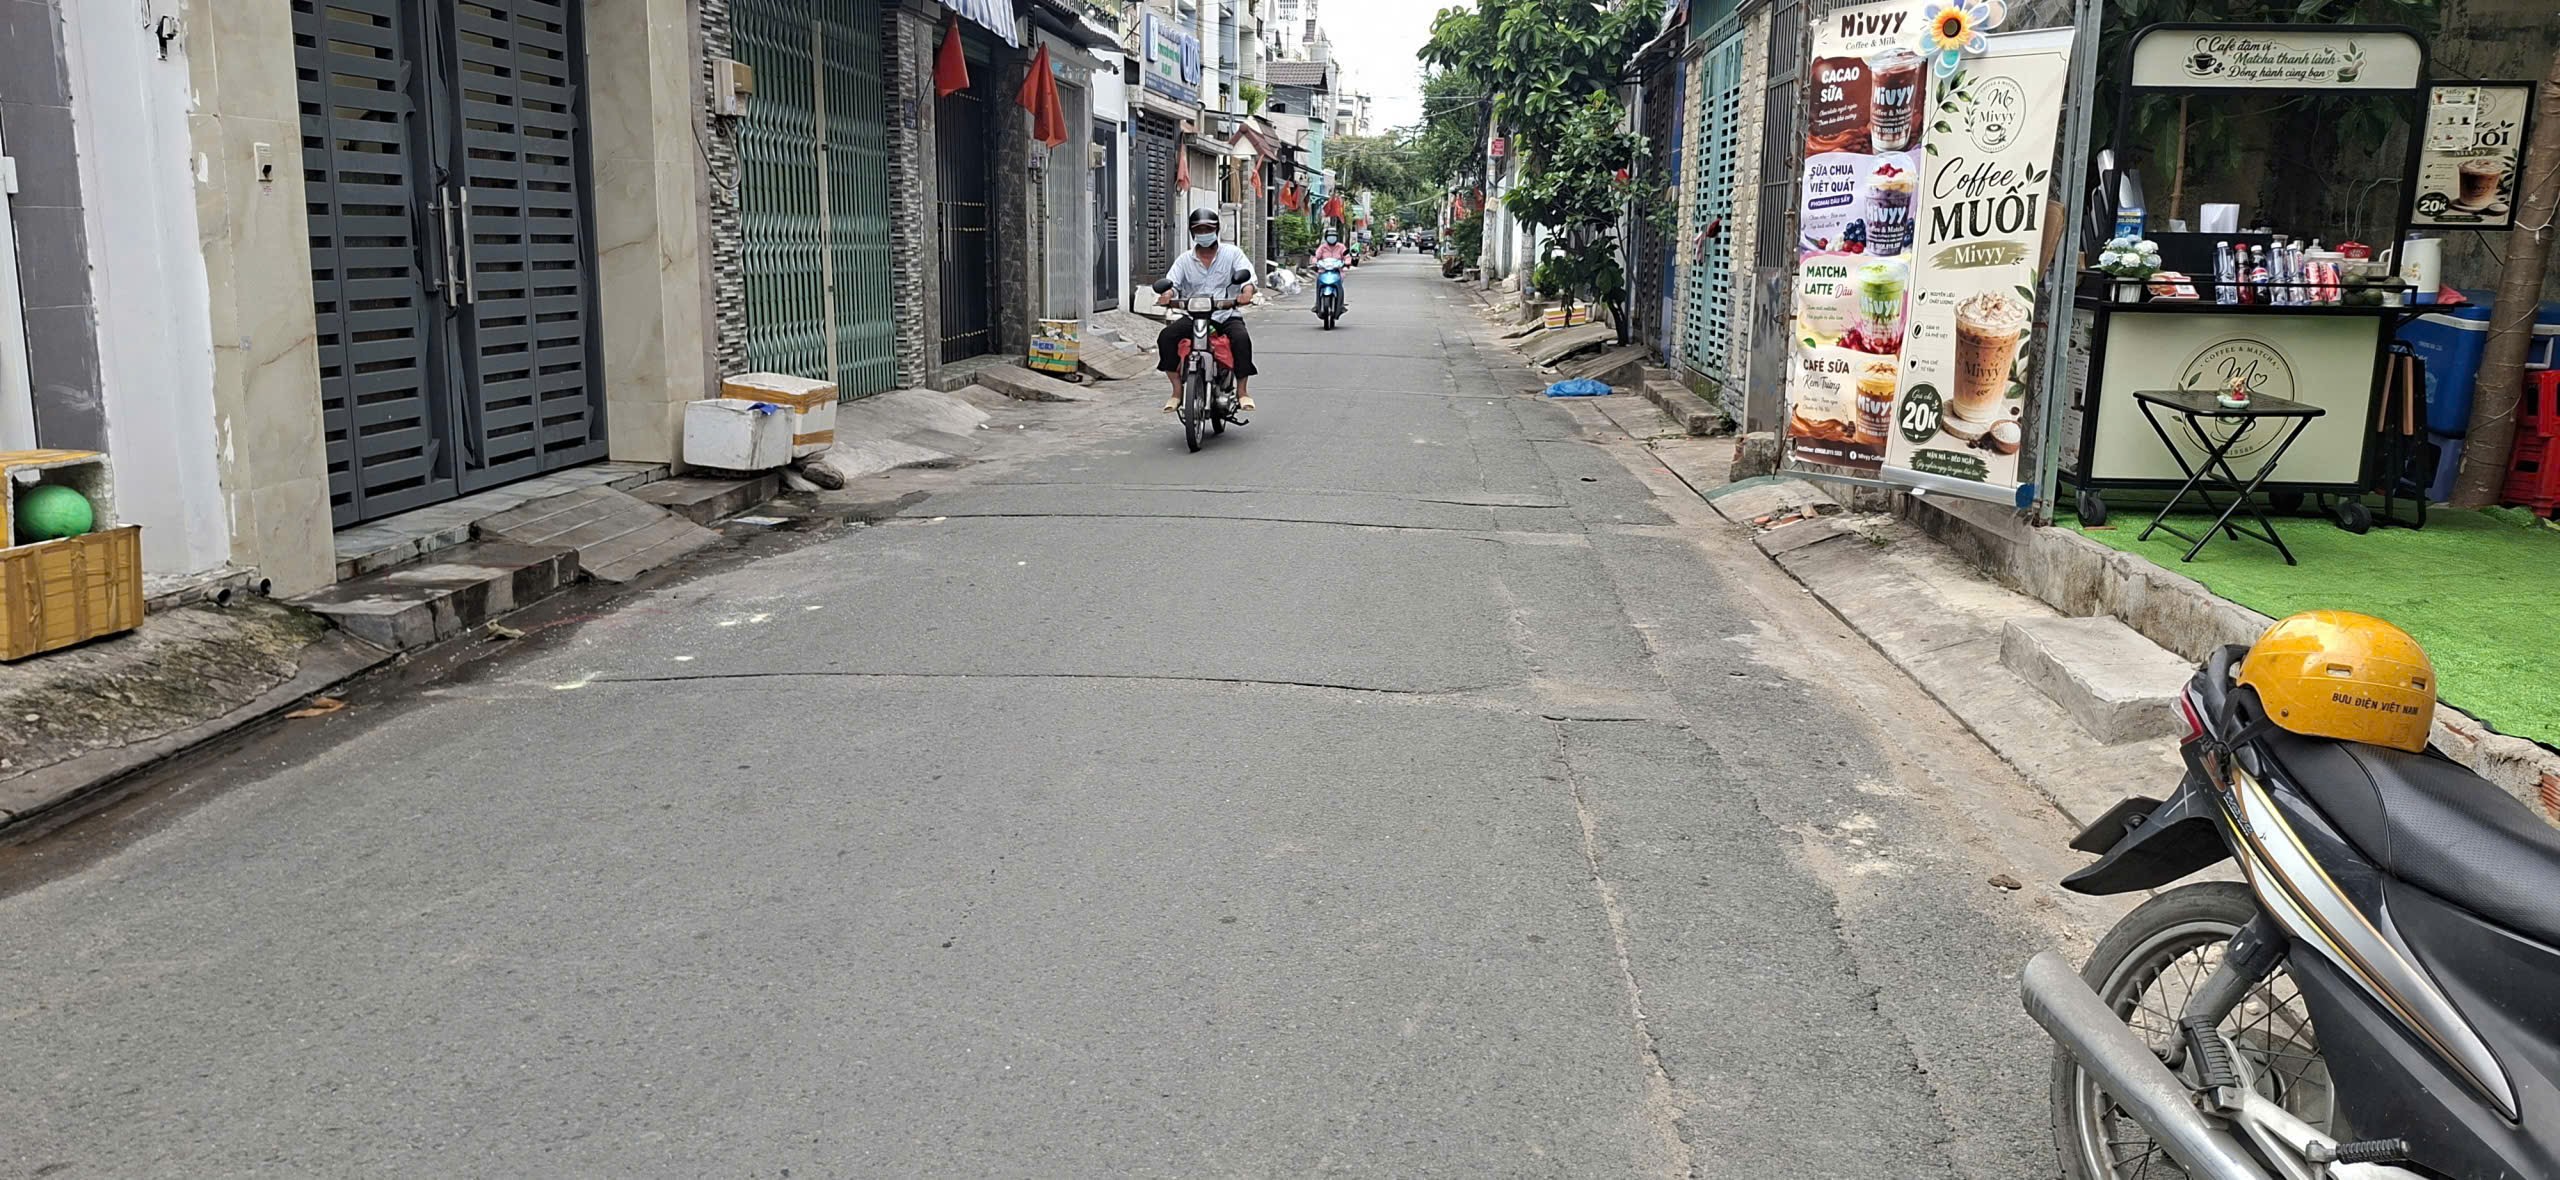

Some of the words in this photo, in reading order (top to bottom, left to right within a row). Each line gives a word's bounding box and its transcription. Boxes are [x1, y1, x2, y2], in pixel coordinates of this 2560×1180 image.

[1841, 11, 1908, 38] Mivyy
[1845, 40, 1868, 50] Coffee
[1879, 37, 1896, 46] Milk
[2208, 36, 2237, 55] Café
[2233, 52, 2275, 65] Matcha
[2276, 52, 2309, 64] thanh
[1821, 66, 1860, 84] CACAO
[2259, 66, 2283, 77] hành
[2308, 66, 2326, 79] bạn
[1820, 85, 1844, 103] SỮA
[1979, 111, 2016, 125] Mivyy
[1829, 164, 1854, 176] CHUA
[1933, 156, 2018, 200] Coffee
[1810, 180, 1829, 195] VIỆT
[1831, 177, 1855, 192] QUẤT
[1928, 181, 2040, 246] MUỐI
[2419, 198, 2447, 212] 20K
[1954, 245, 2006, 265] Mivyy
[1806, 266, 1848, 279] MATCHA
[1804, 284, 1834, 295] LATTE
[2204, 346, 2236, 363] COFFEE
[2246, 346, 2278, 367] MATCHA
[1803, 358, 1825, 373] CAFÉ
[1827, 359, 1850, 374] SỮA
[1964, 360, 2001, 382] Mivyy
[1901, 401, 1939, 432] 20K
[2354, 697, 2379, 709] ĐIỆN
[2381, 702, 2401, 713] VIỆT
[2402, 706, 2420, 715] NAM
